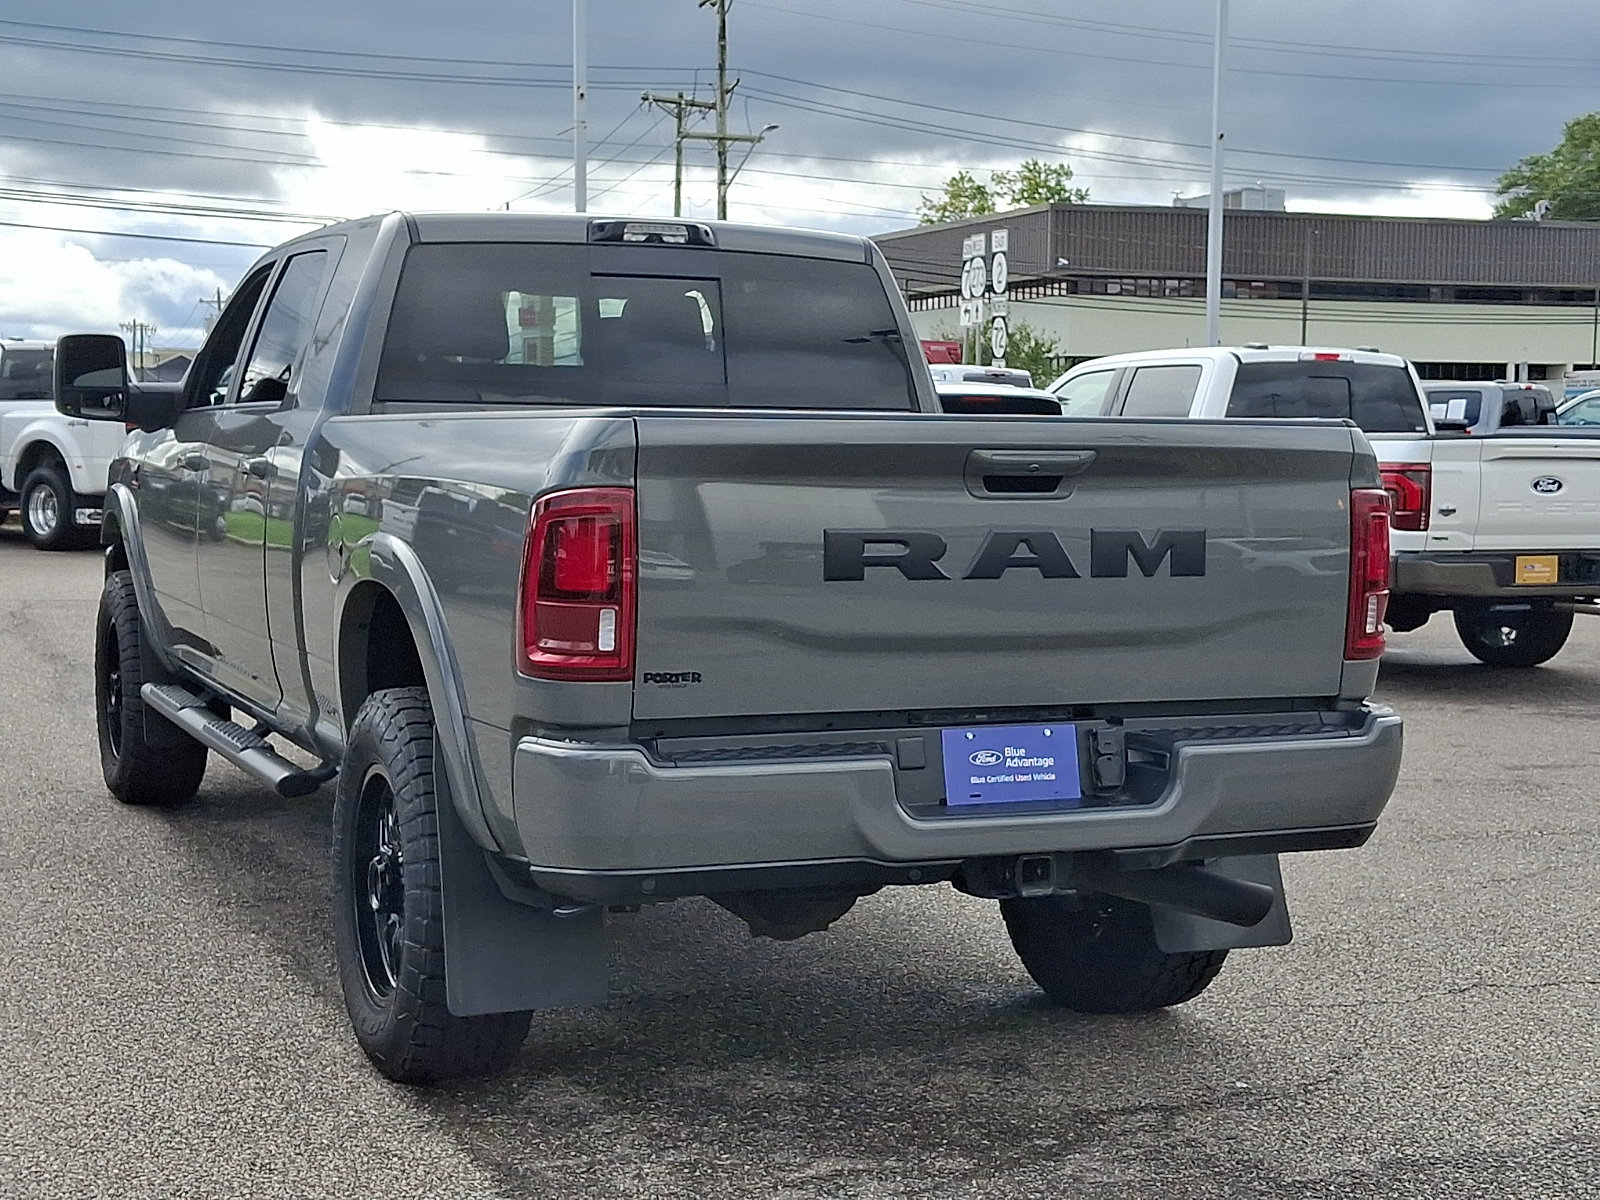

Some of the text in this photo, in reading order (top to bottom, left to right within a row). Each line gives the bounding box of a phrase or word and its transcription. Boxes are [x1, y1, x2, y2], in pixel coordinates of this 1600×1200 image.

[997, 262, 1003, 284] 2
[994, 326, 1004, 349] 72
[823, 528, 1206, 581] RAM
[643, 671, 702, 684] PORTER
[1004, 746, 1026, 757] Blue
[1005, 756, 1055, 768] Advantage
[970, 772, 1056, 784] Blue Certified Used Vehicle
